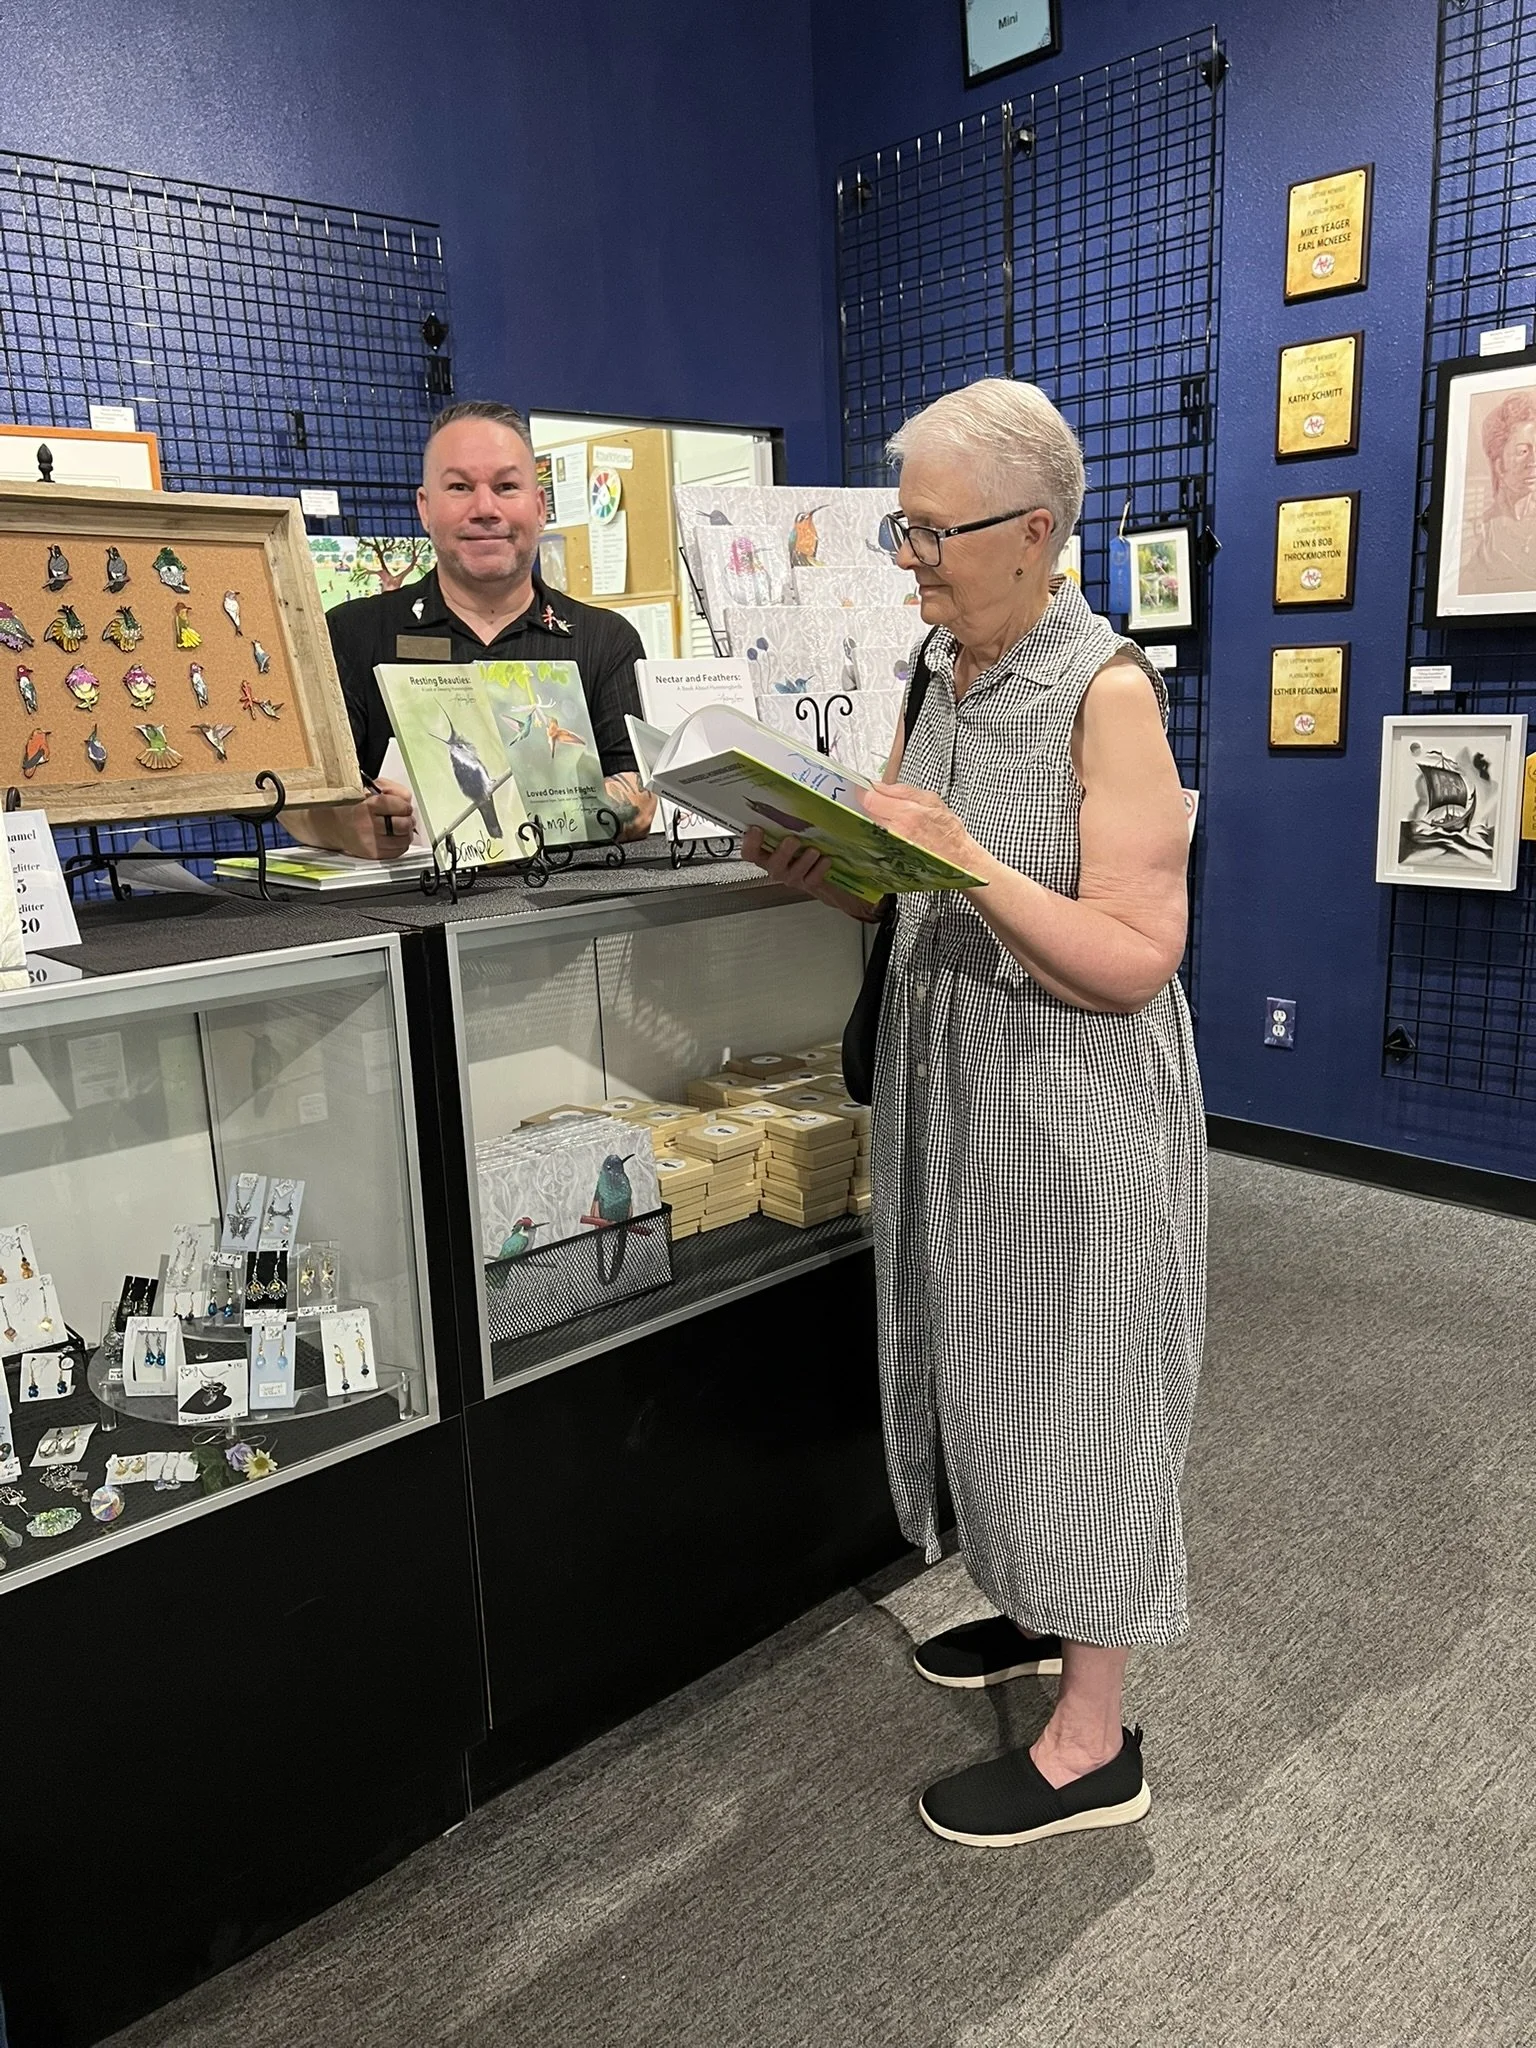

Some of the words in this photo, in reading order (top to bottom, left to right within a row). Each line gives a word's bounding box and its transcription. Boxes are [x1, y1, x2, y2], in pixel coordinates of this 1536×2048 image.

[998, 11, 1019, 30] Mini
[1300, 225, 1319, 238] MIKE
[1321, 218, 1350, 233] YEAGER
[1297, 241, 1315, 252] EARL
[1317, 232, 1352, 247] MCNEESE
[1287, 393, 1310, 404] KATHY
[1311, 387, 1343, 401] SCHMITT
[1292, 539, 1310, 549] LYNN
[1318, 537, 1333, 547] BOB
[1284, 550, 1341, 561] THROCKMORTON
[409, 676, 438, 687] Resting
[438, 675, 472, 685] Beauties:
[655, 675, 683, 684] Nectar
[685, 674, 701, 683] and
[702, 673, 741, 682] Feathers:
[1274, 687, 1296, 696] ESTHER
[1297, 687, 1338, 696] FEIGENBAUM
[526, 788, 548, 798] Loved
[548, 787, 566, 796] Ones
[574, 785, 597, 795] Flight:
[12, 862, 41, 874] glitter
